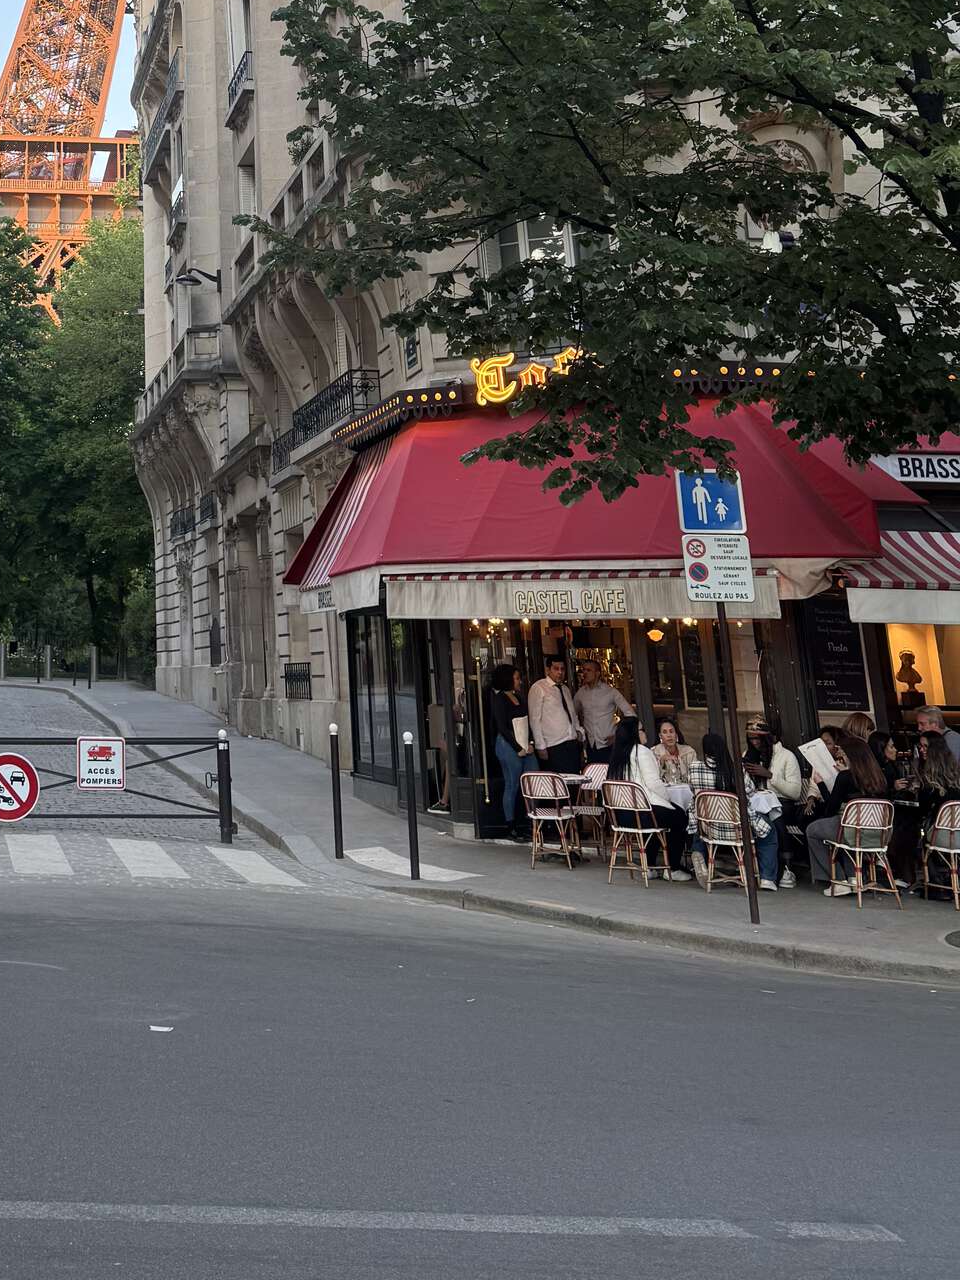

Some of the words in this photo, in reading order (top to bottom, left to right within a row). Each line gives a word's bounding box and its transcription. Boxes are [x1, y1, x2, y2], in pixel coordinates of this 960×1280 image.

[695, 592, 723, 600] ROULEZ
[515, 590, 579, 614] CASTEL
[581, 589, 625, 613] CAFE
[87, 767, 116, 775] ACCÈS
[80, 777, 122, 785] POMPIERS
